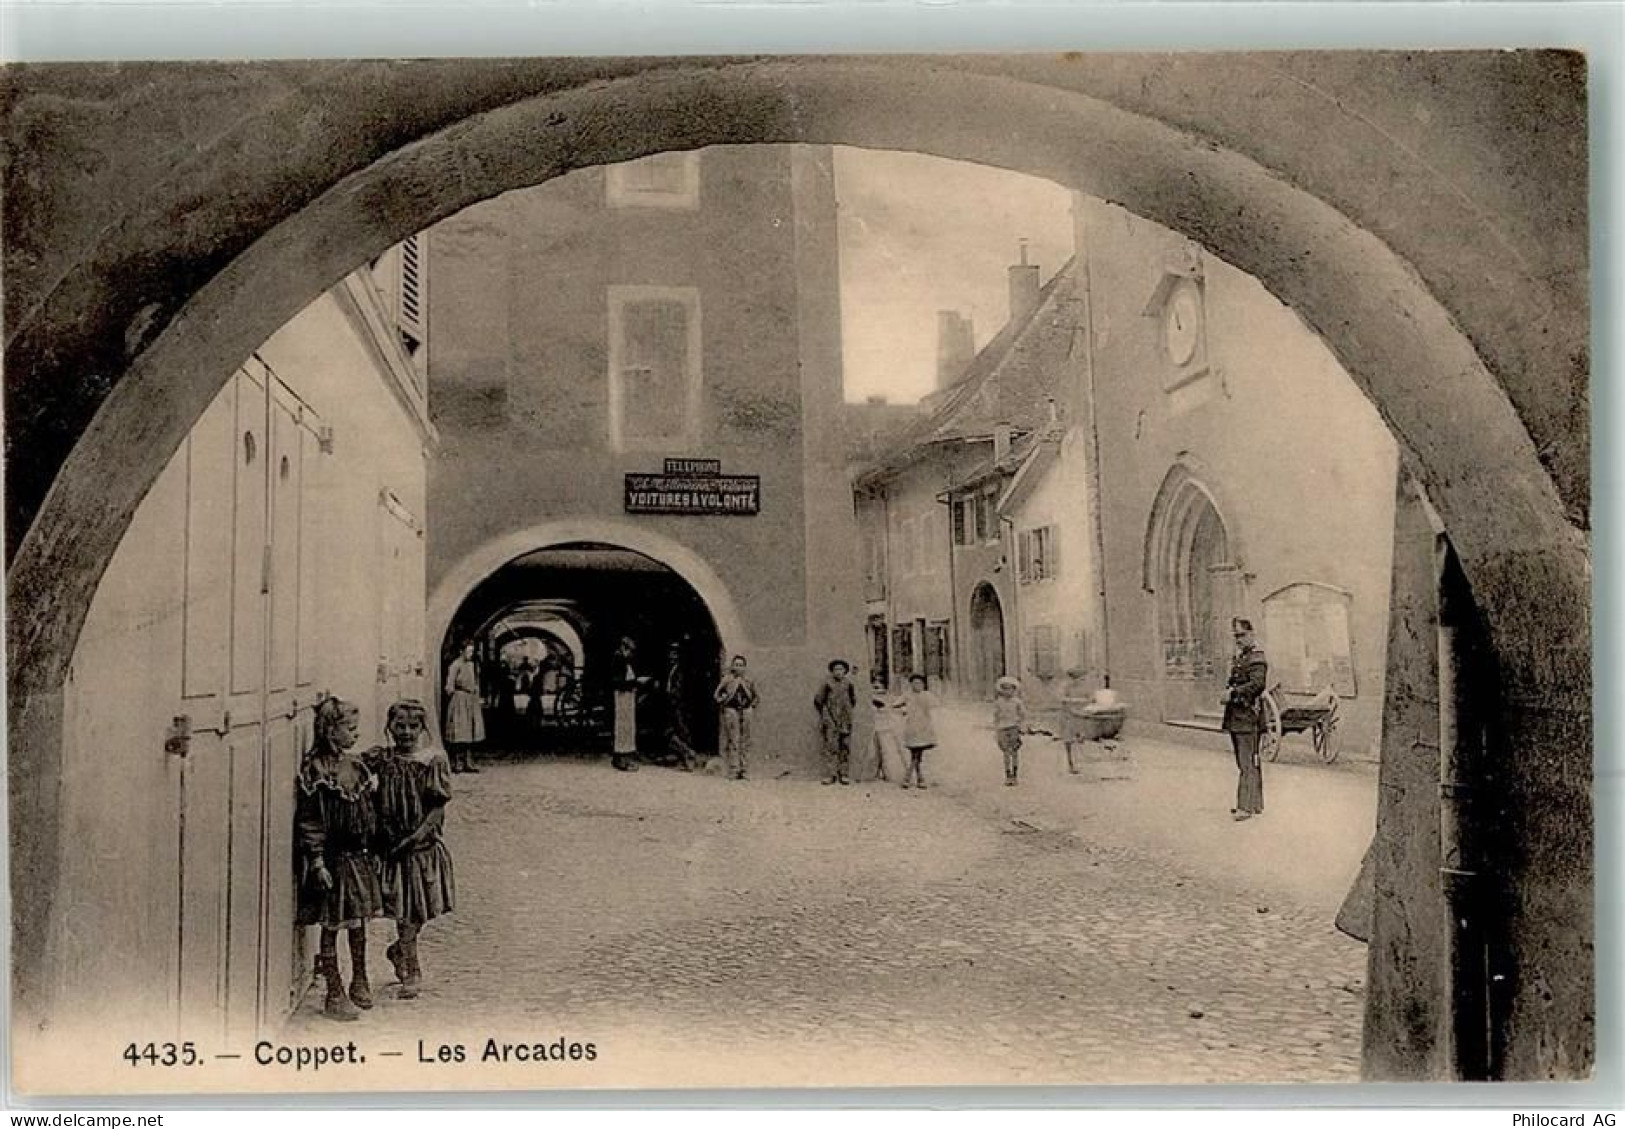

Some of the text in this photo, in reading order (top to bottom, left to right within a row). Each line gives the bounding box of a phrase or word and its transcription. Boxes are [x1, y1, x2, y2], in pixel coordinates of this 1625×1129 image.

[630, 492, 690, 507] VOITURES
[124, 1043, 204, 1067] 4435.
[254, 1042, 366, 1071] Coppet.
[418, 1040, 466, 1063] Les
[482, 1038, 598, 1062] Arcades
